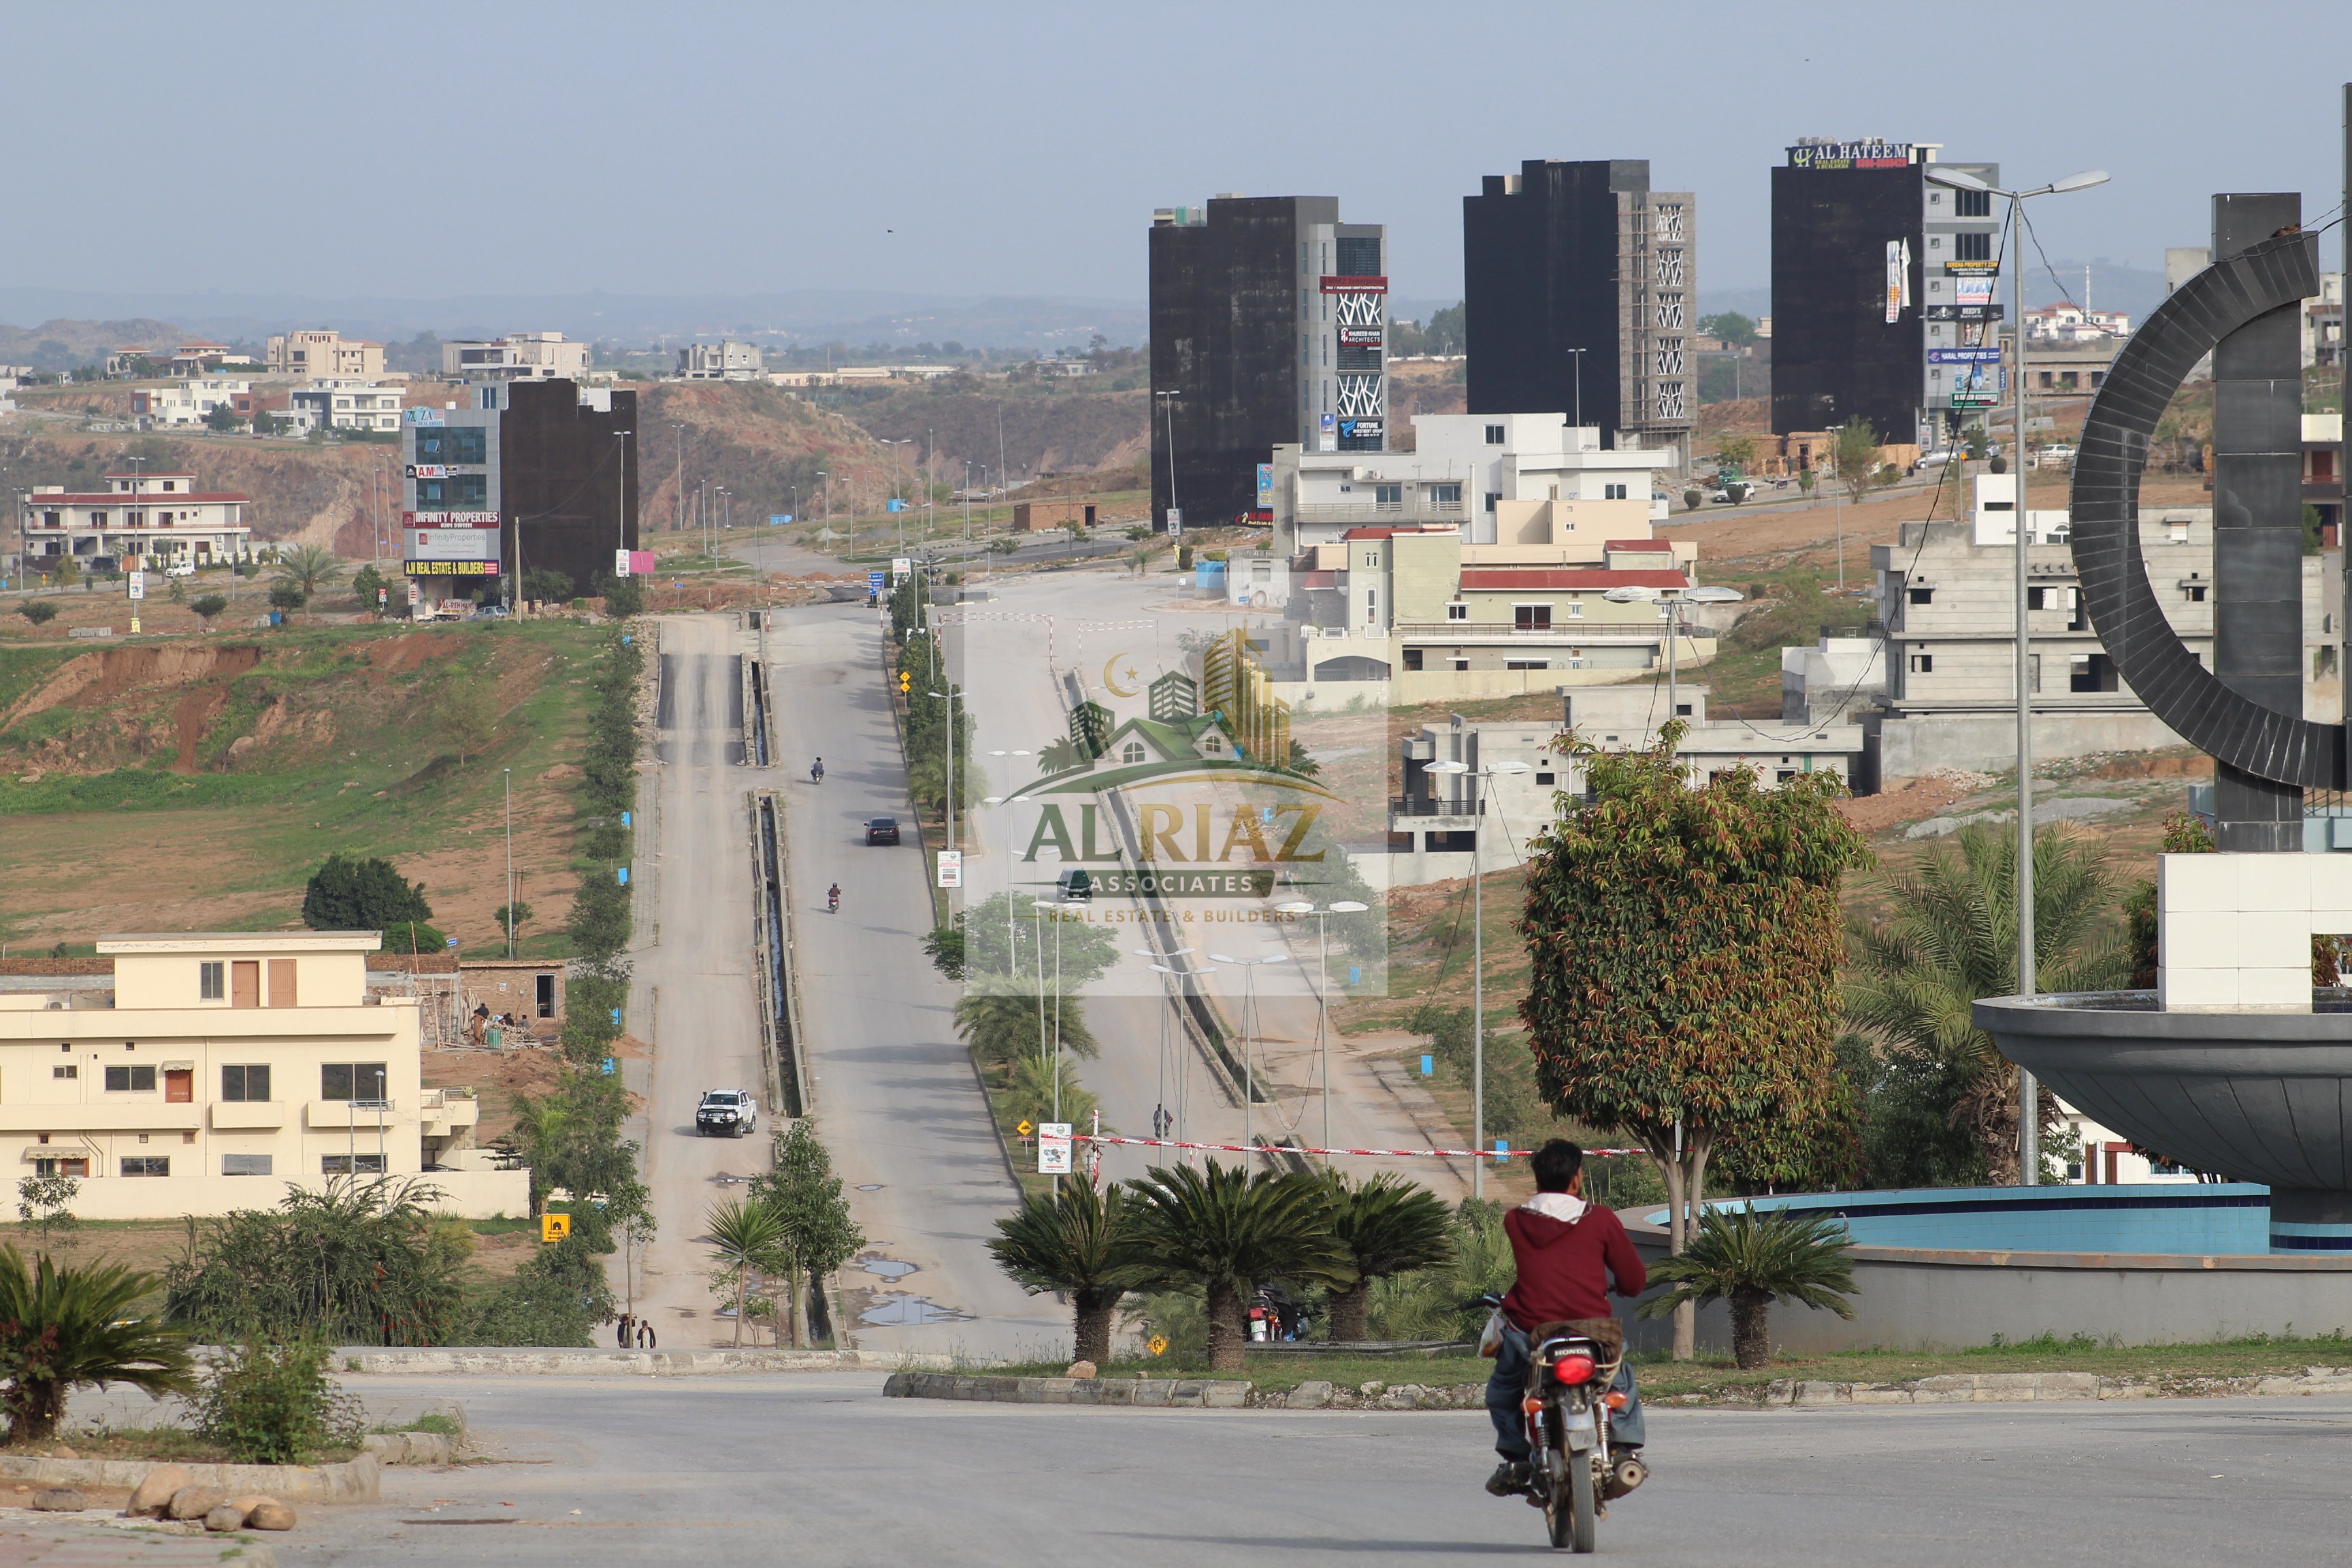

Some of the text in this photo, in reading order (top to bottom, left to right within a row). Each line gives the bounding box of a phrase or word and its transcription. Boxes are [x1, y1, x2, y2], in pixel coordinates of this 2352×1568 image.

[1814, 144, 1907, 159] AL HATEEM
[421, 410, 433, 421] ZA
[419, 466, 434, 477] A.M
[416, 512, 498, 523] INFINITY PROPERTIES
[428, 534, 486, 542] InfinityProperties
[406, 561, 416, 574] A.M
[416, 561, 430, 574] REAL
[431, 561, 451, 574] ESTATE
[453, 562, 457, 574] &
[458, 561, 485, 574] BUILDERS
[1554, 1348, 1590, 1356] HONDA
